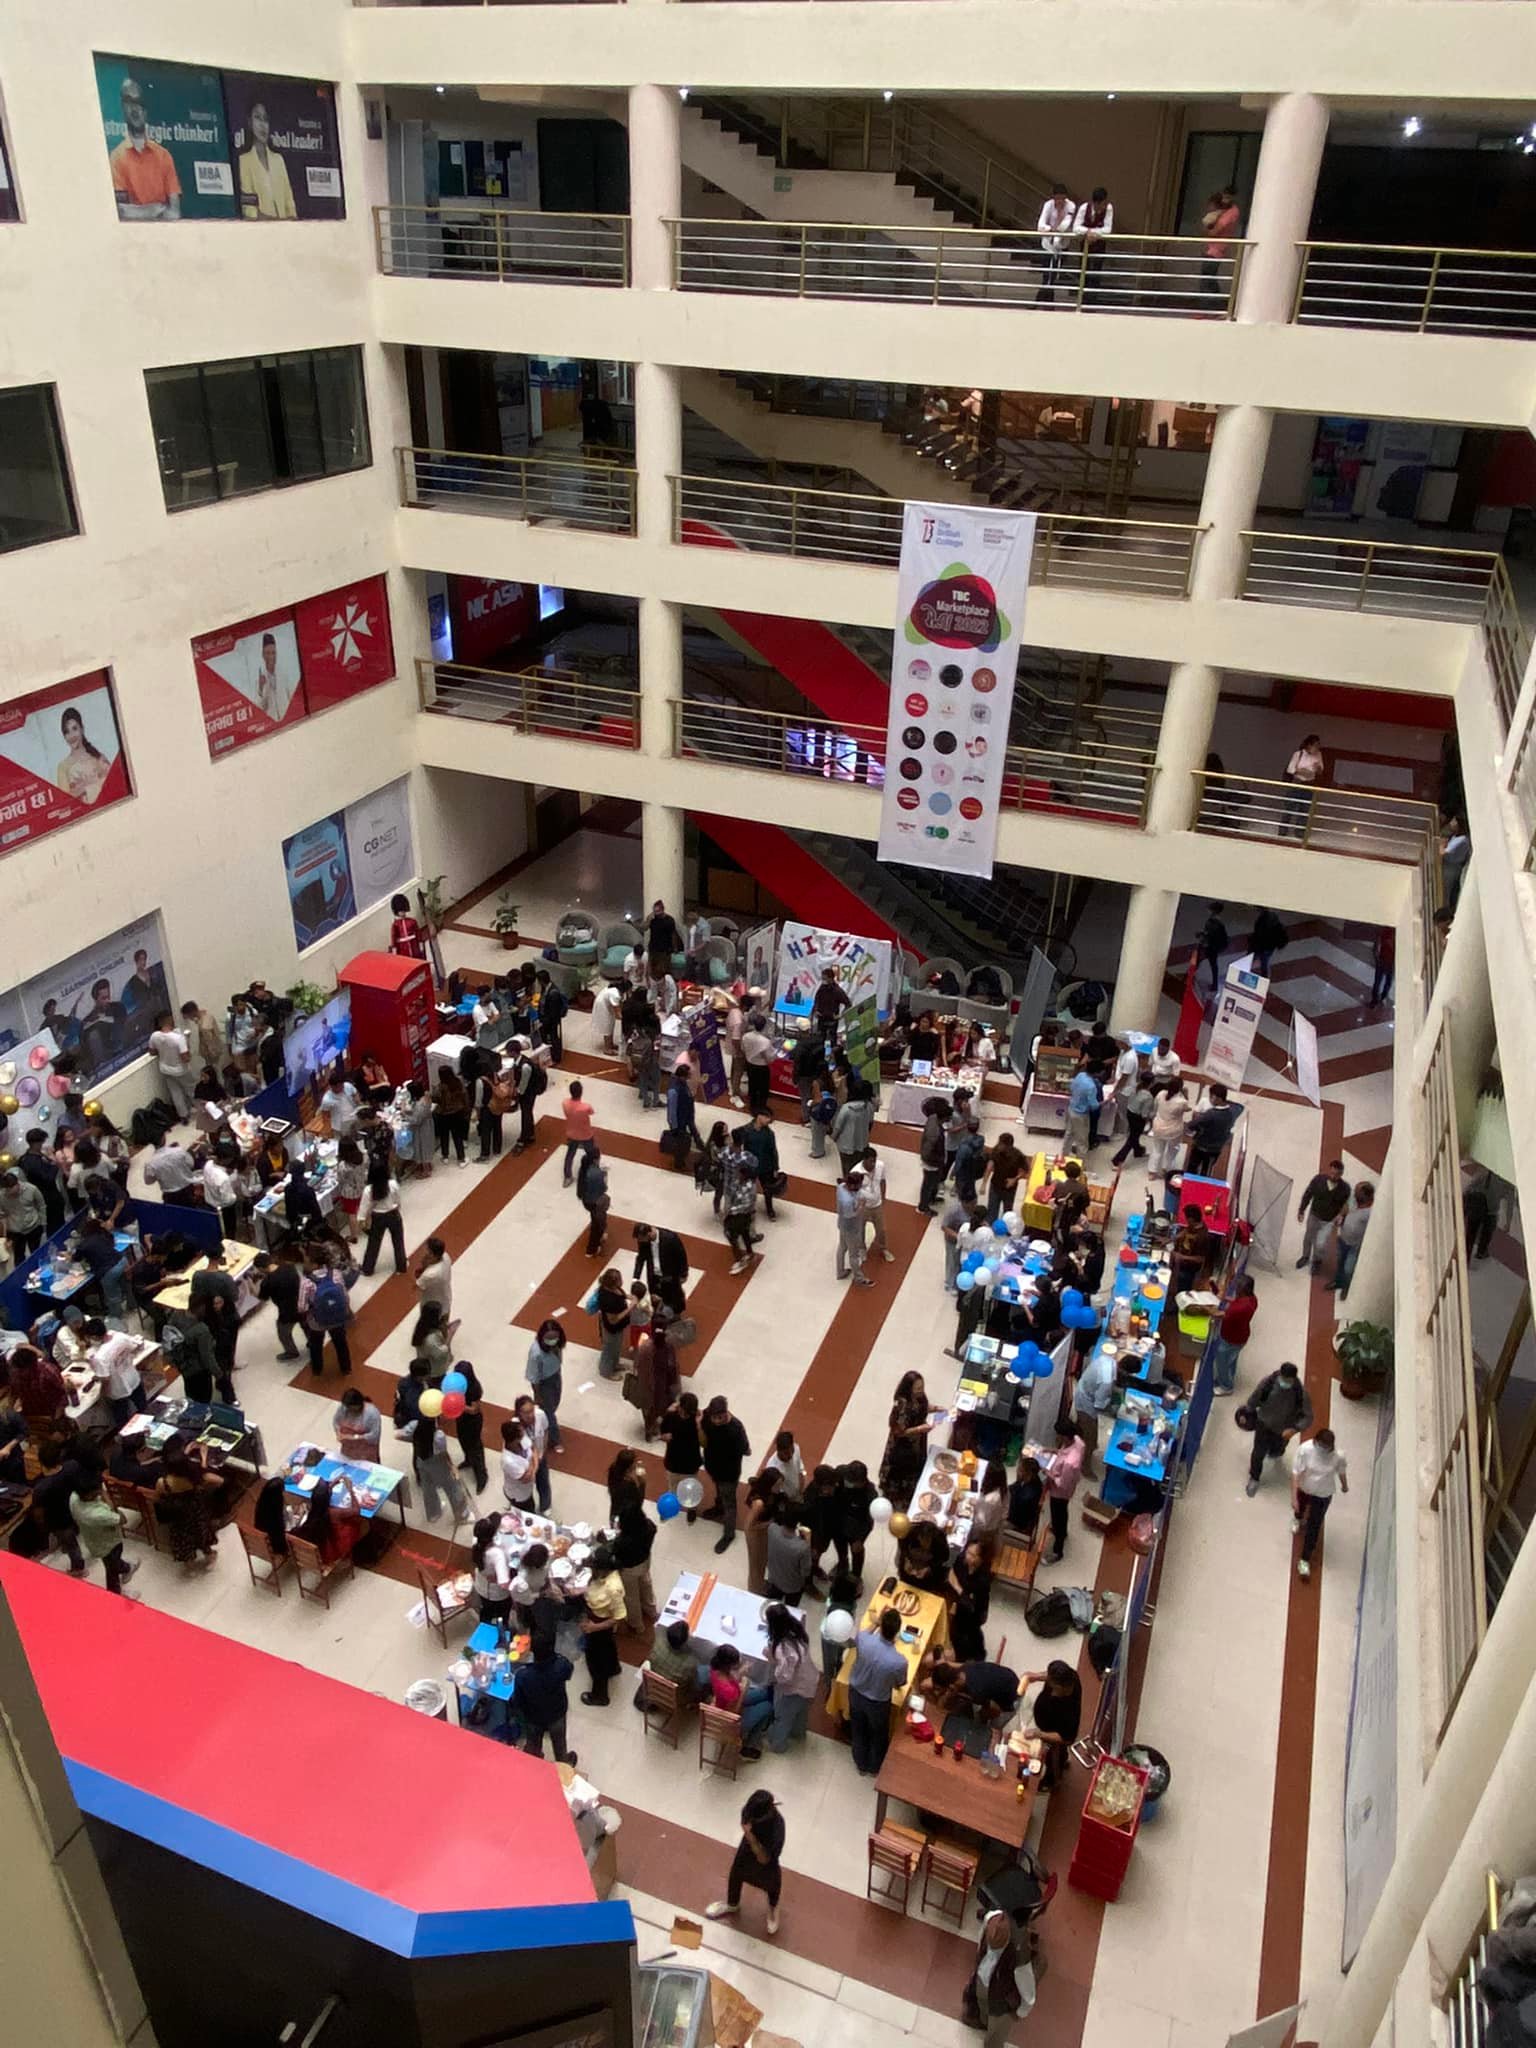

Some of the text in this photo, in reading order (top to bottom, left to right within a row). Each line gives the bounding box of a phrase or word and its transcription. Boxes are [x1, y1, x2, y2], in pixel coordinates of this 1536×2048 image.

[174, 123, 218, 143] thinker!
[291, 132, 323, 150] leader!
[198, 165, 221, 180] MBA
[938, 519, 951, 528] The
[466, 584, 524, 621] NIC ASIA
[936, 600, 990, 616] Marketplace
[61, 972, 97, 998] LEARNING
